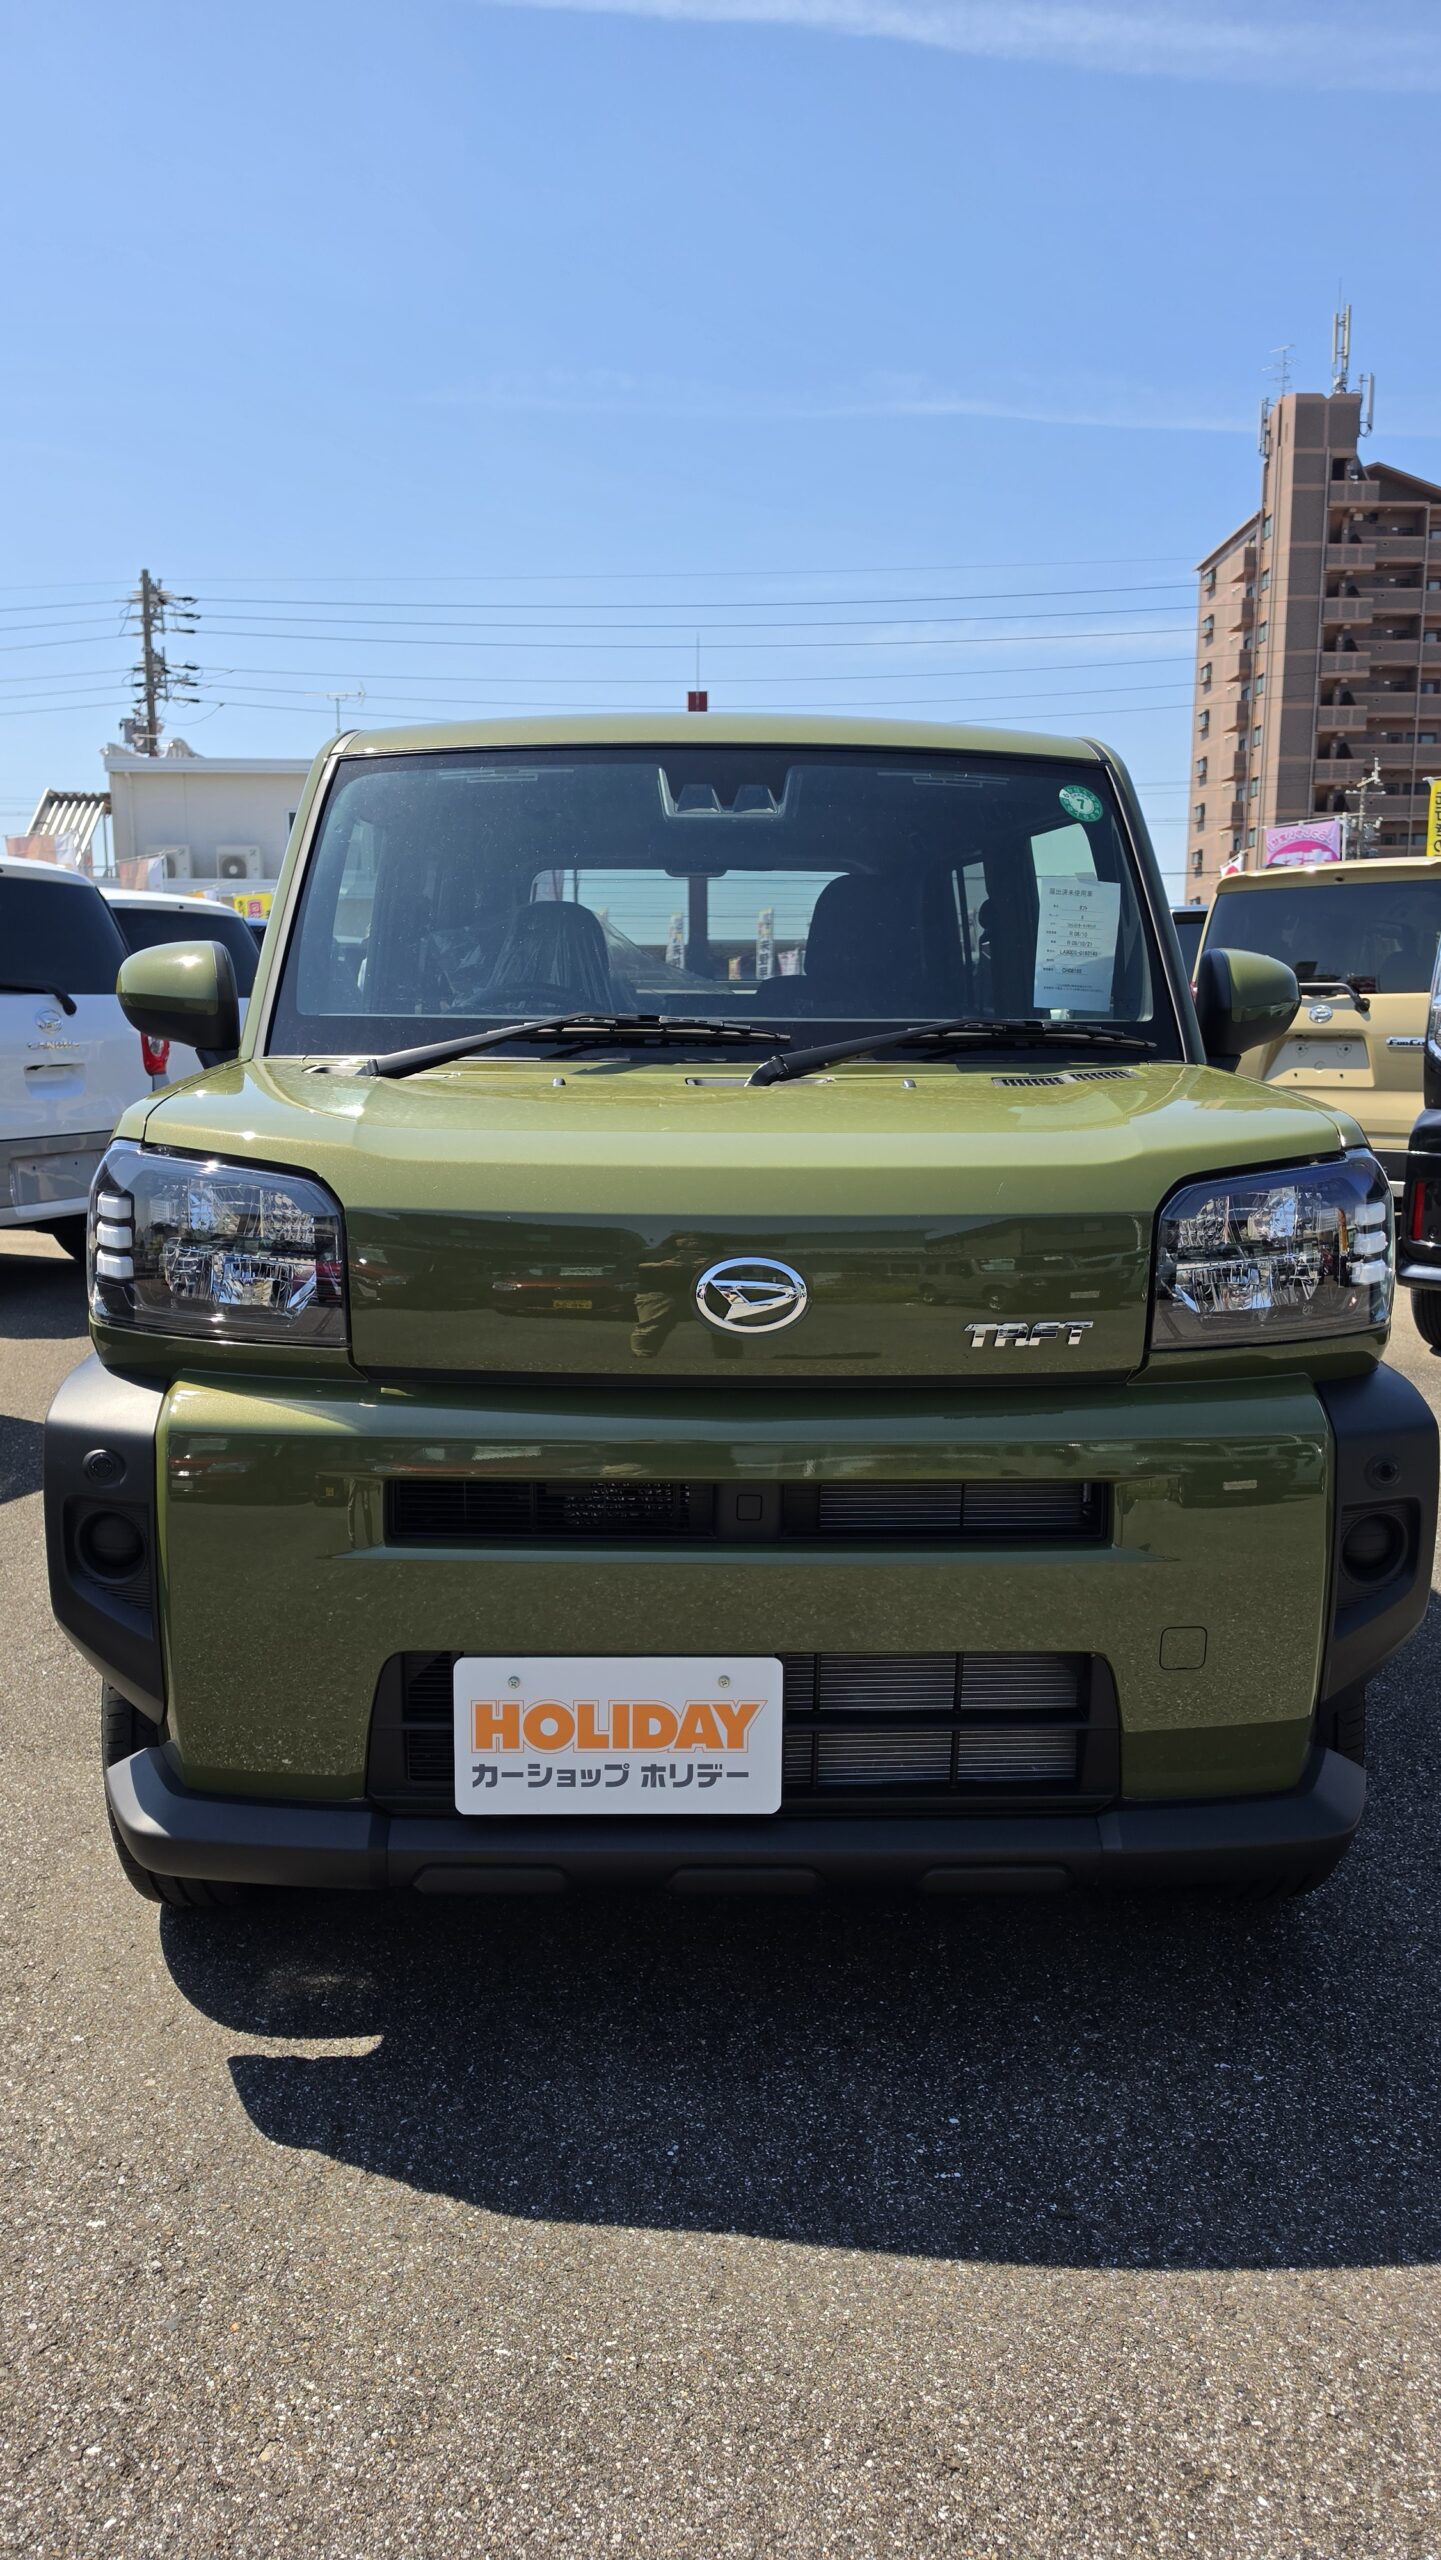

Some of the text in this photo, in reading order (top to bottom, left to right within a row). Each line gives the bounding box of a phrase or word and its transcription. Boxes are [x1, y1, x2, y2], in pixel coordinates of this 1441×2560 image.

[1076, 798, 1085, 810] 7
[964, 1321, 1094, 1348] TAFT
[470, 1699, 768, 1754] HOLIDAY
[471, 1763, 749, 1788] カーショップ ホリデー
